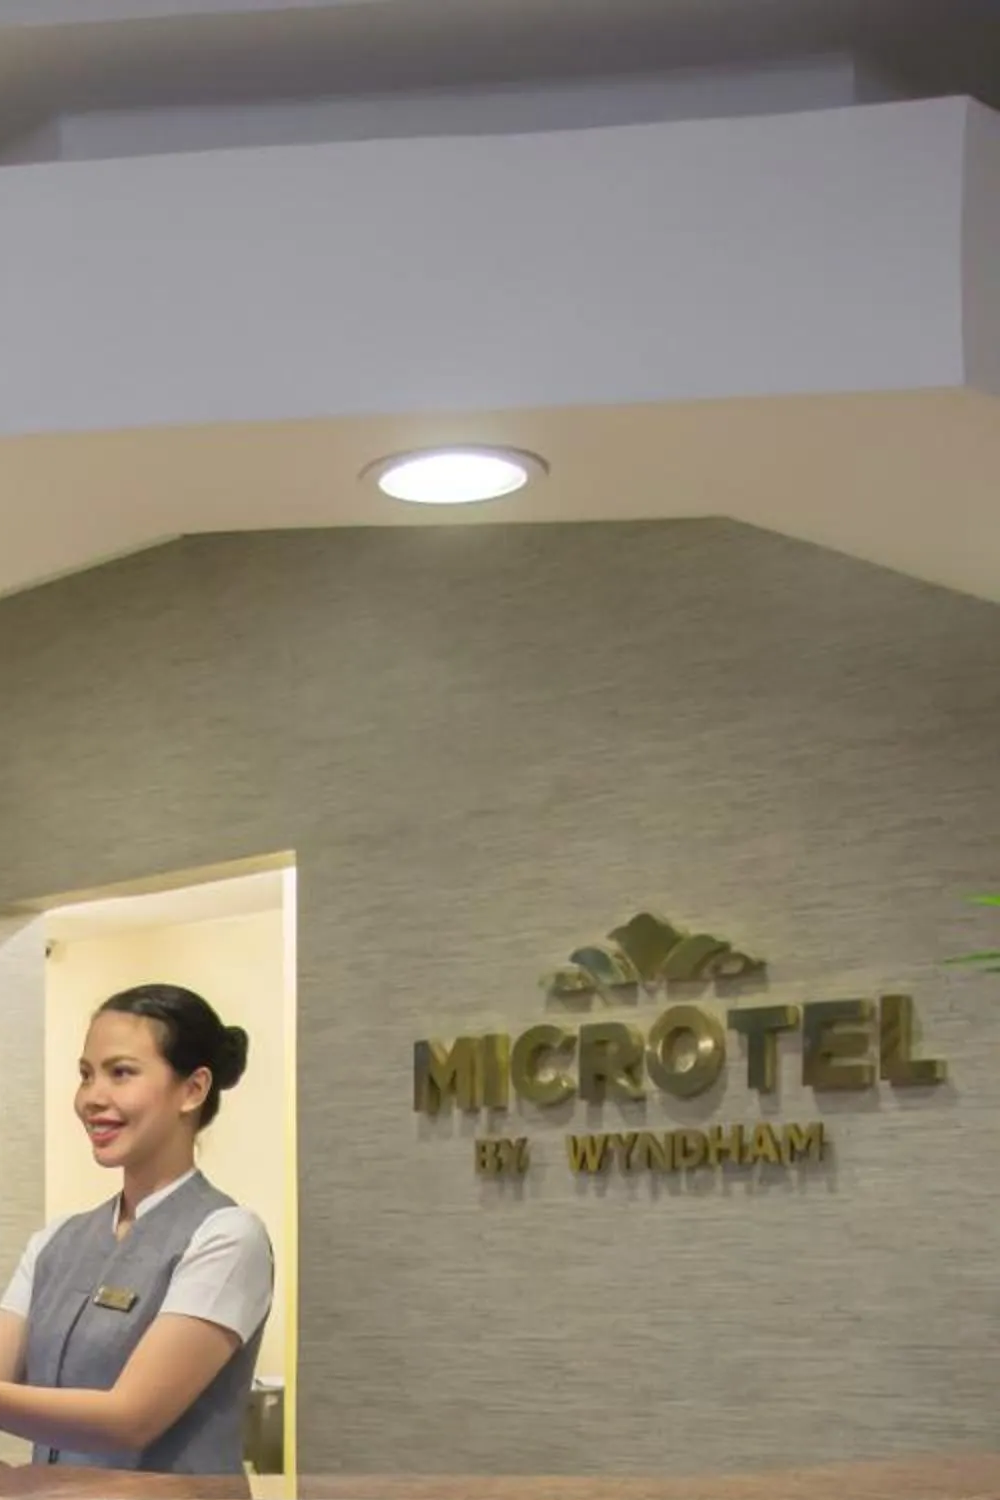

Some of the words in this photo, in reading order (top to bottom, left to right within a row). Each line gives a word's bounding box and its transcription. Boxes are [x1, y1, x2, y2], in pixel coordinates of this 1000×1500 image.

[414, 994, 946, 1113] MICROTEL
[475, 1137, 528, 1174] BY
[567, 1122, 824, 1173] WYNDHAM
